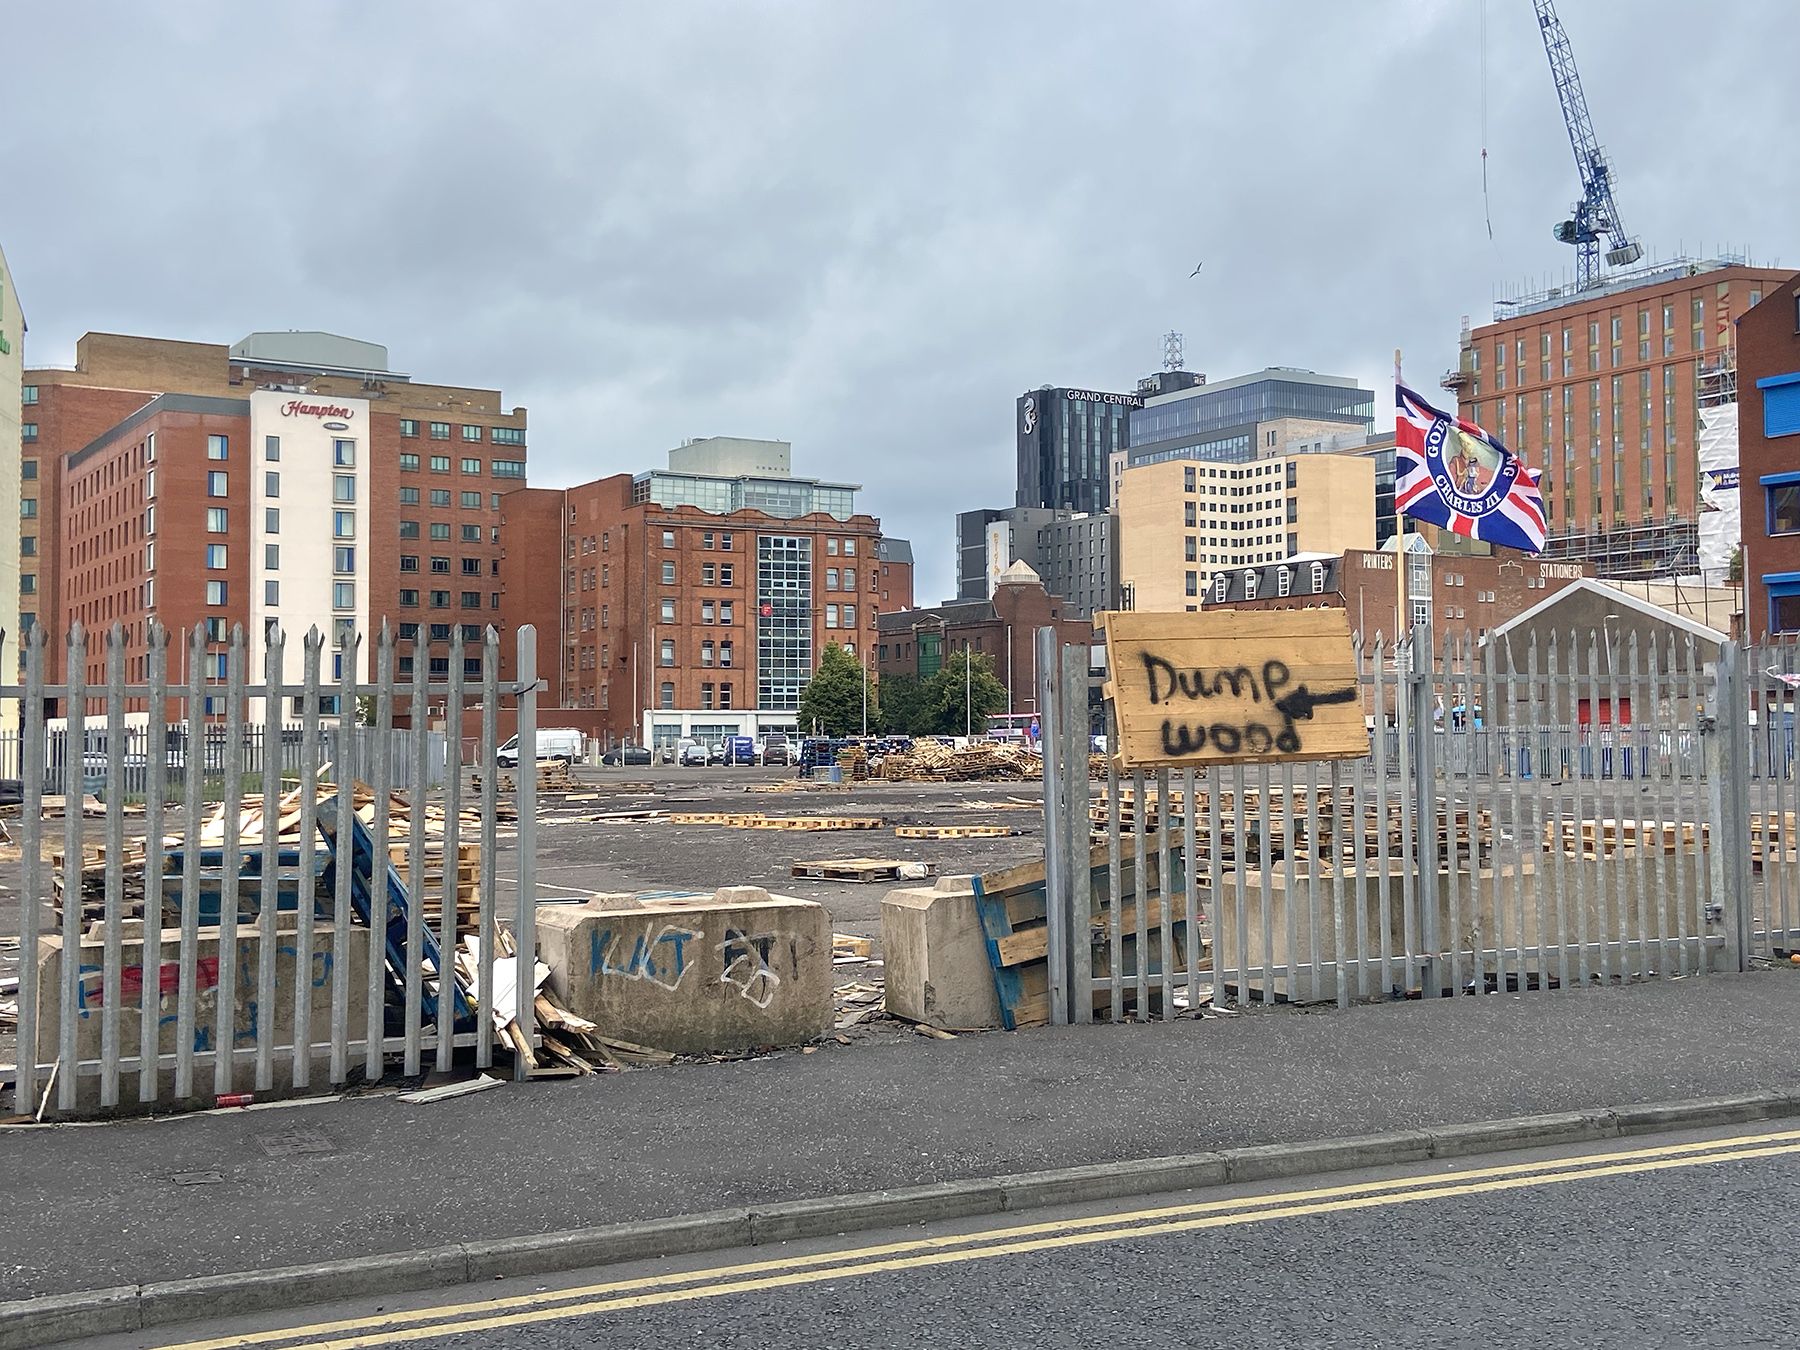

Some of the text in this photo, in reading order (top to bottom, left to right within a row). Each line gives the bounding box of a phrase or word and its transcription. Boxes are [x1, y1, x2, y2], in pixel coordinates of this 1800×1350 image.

[1066, 389, 1144, 407] GRAND CENTRAL
[280, 400, 355, 420] Hampton
[1435, 474, 1502, 514] CHARLES III
[1362, 553, 1393, 570] PRINTERS
[1540, 562, 1583, 579] STATIONERS
